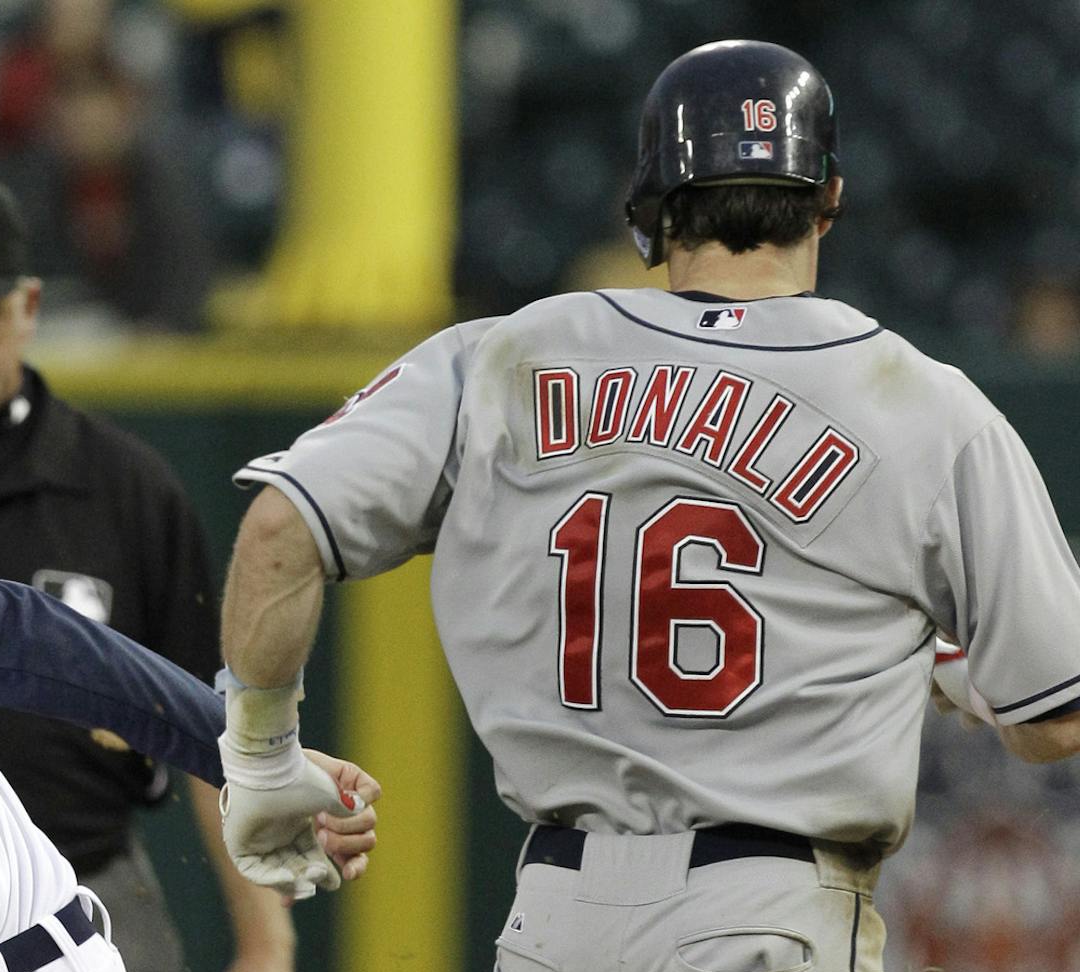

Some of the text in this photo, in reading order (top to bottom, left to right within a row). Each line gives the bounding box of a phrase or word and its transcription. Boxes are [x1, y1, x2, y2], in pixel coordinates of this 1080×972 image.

[741, 99, 777, 132] 16
[533, 365, 860, 524] DONALD
[548, 490, 766, 719] 16
